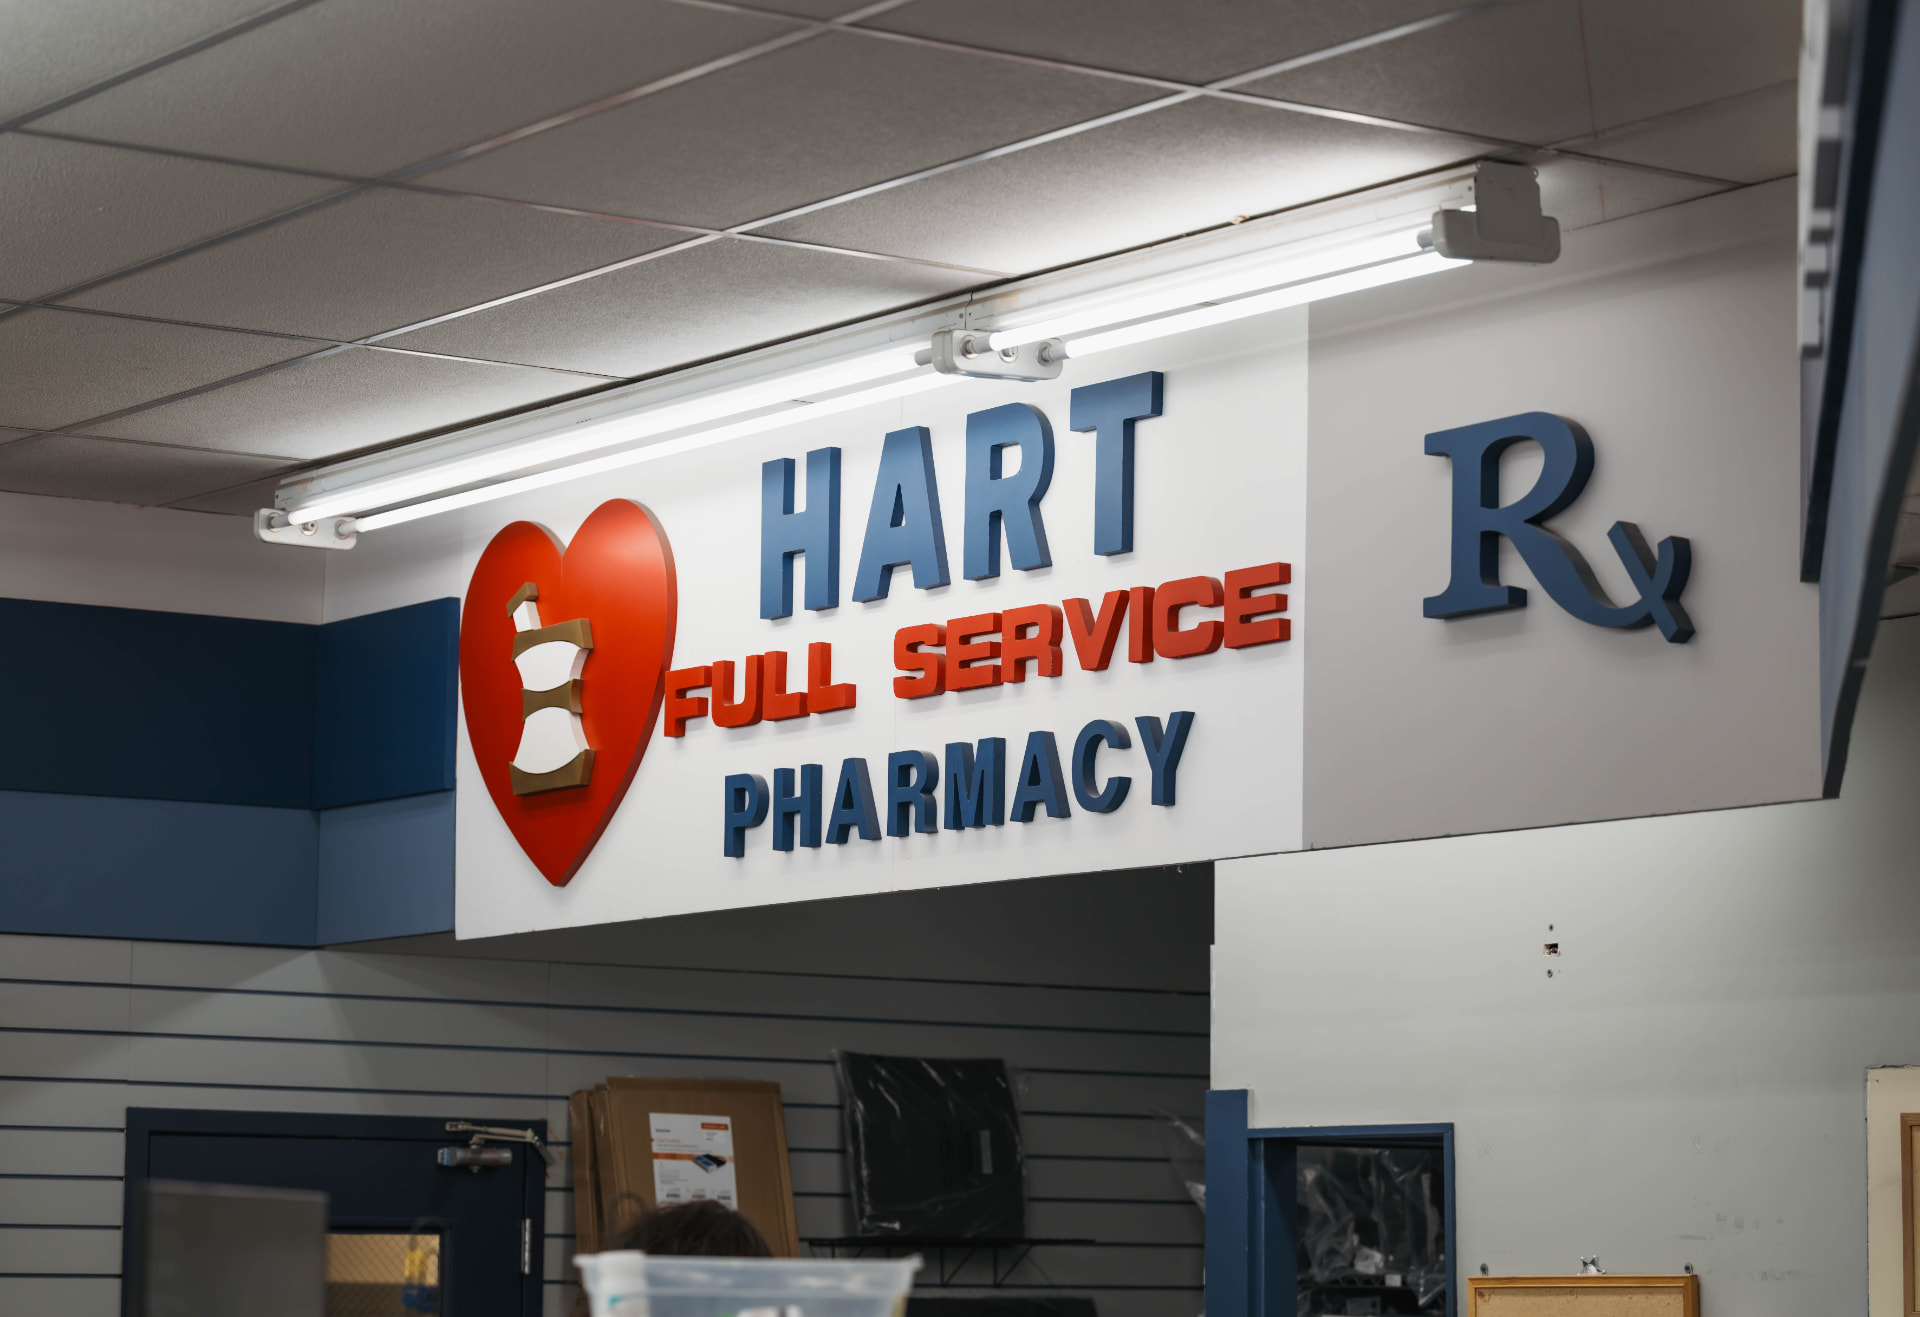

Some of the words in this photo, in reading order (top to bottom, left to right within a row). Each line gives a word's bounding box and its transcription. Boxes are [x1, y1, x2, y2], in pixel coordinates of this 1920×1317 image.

[760, 371, 1163, 620] HART
[1423, 411, 1696, 644] Rx
[663, 642, 856, 737] FULL
[893, 562, 1292, 699] SERVICE
[723, 711, 1195, 858] PHARMACY
